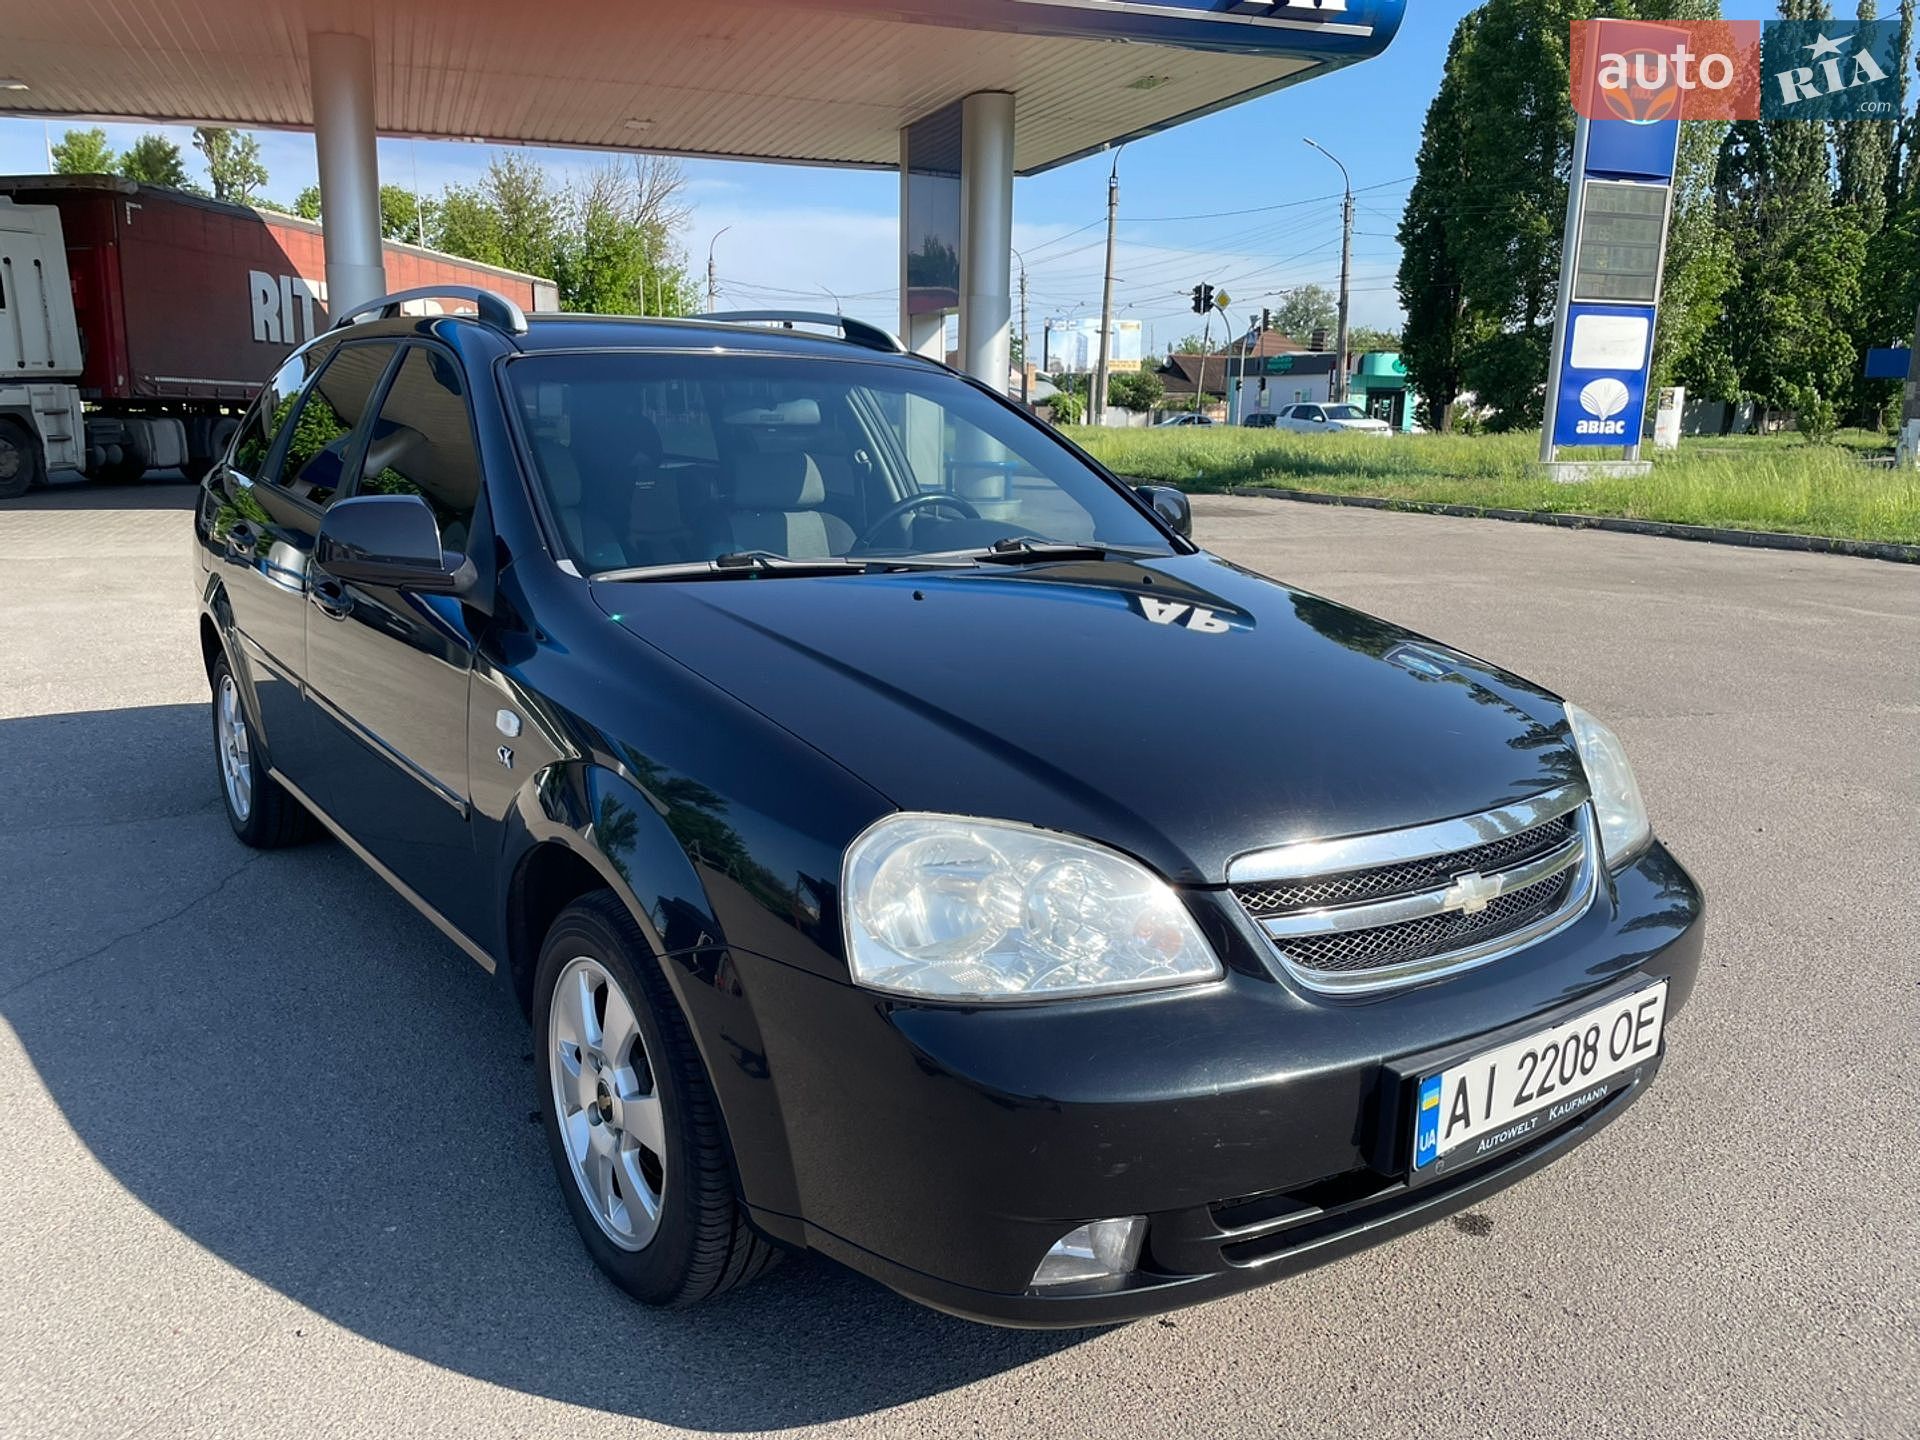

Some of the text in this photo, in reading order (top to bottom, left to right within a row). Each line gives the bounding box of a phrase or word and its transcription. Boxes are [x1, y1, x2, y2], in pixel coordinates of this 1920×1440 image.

[249, 270, 328, 344] RIT
[1444, 997, 1658, 1140] AI 2208 OE
[1419, 1130, 1437, 1151] UA
[1476, 1084, 1609, 1154] AUTOWELT KAUFMANN
